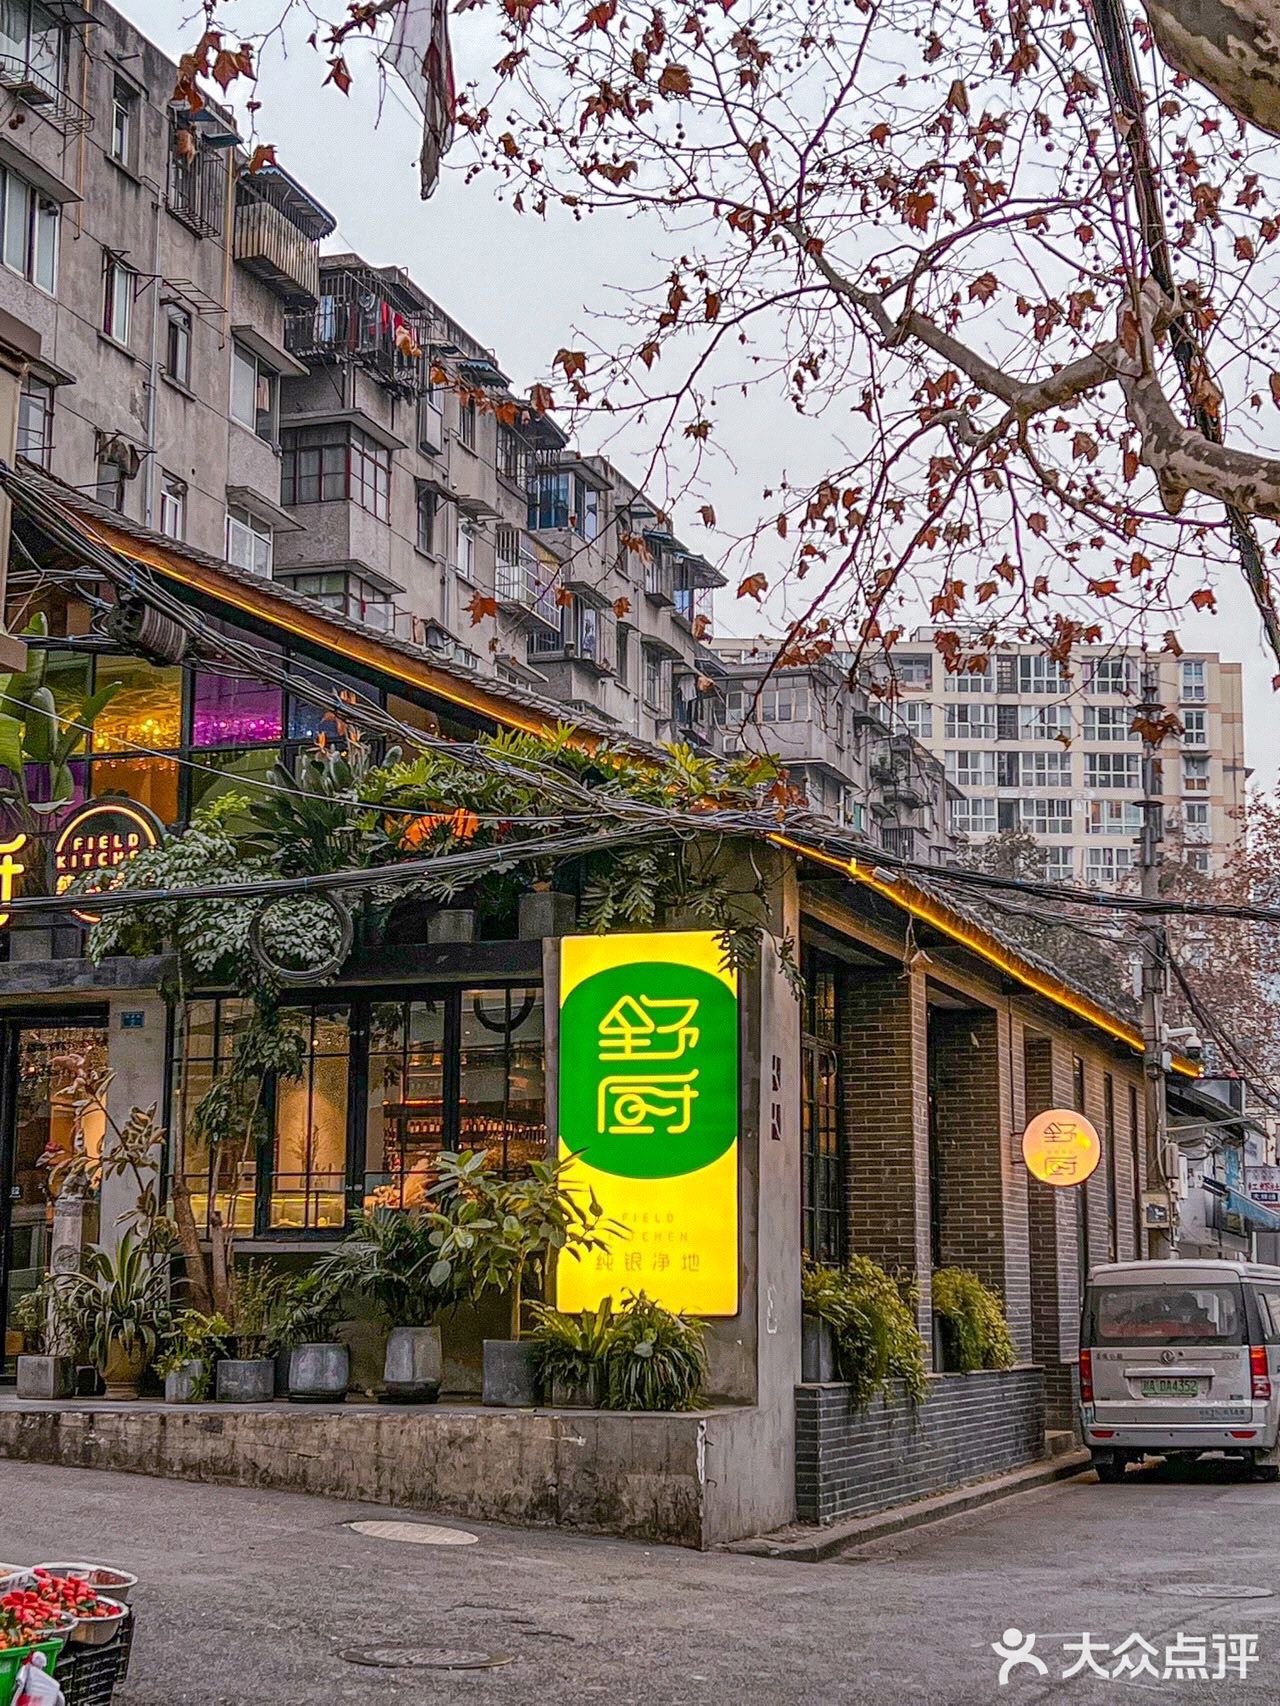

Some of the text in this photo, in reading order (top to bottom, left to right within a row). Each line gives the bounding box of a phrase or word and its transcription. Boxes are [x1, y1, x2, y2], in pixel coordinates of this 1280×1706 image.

[73, 832, 140, 851] FIELD
[56, 850, 142, 869] KITCHE
[621, 1212, 675, 1224] FIELD
[595, 1250, 701, 1273] 纯银净地
